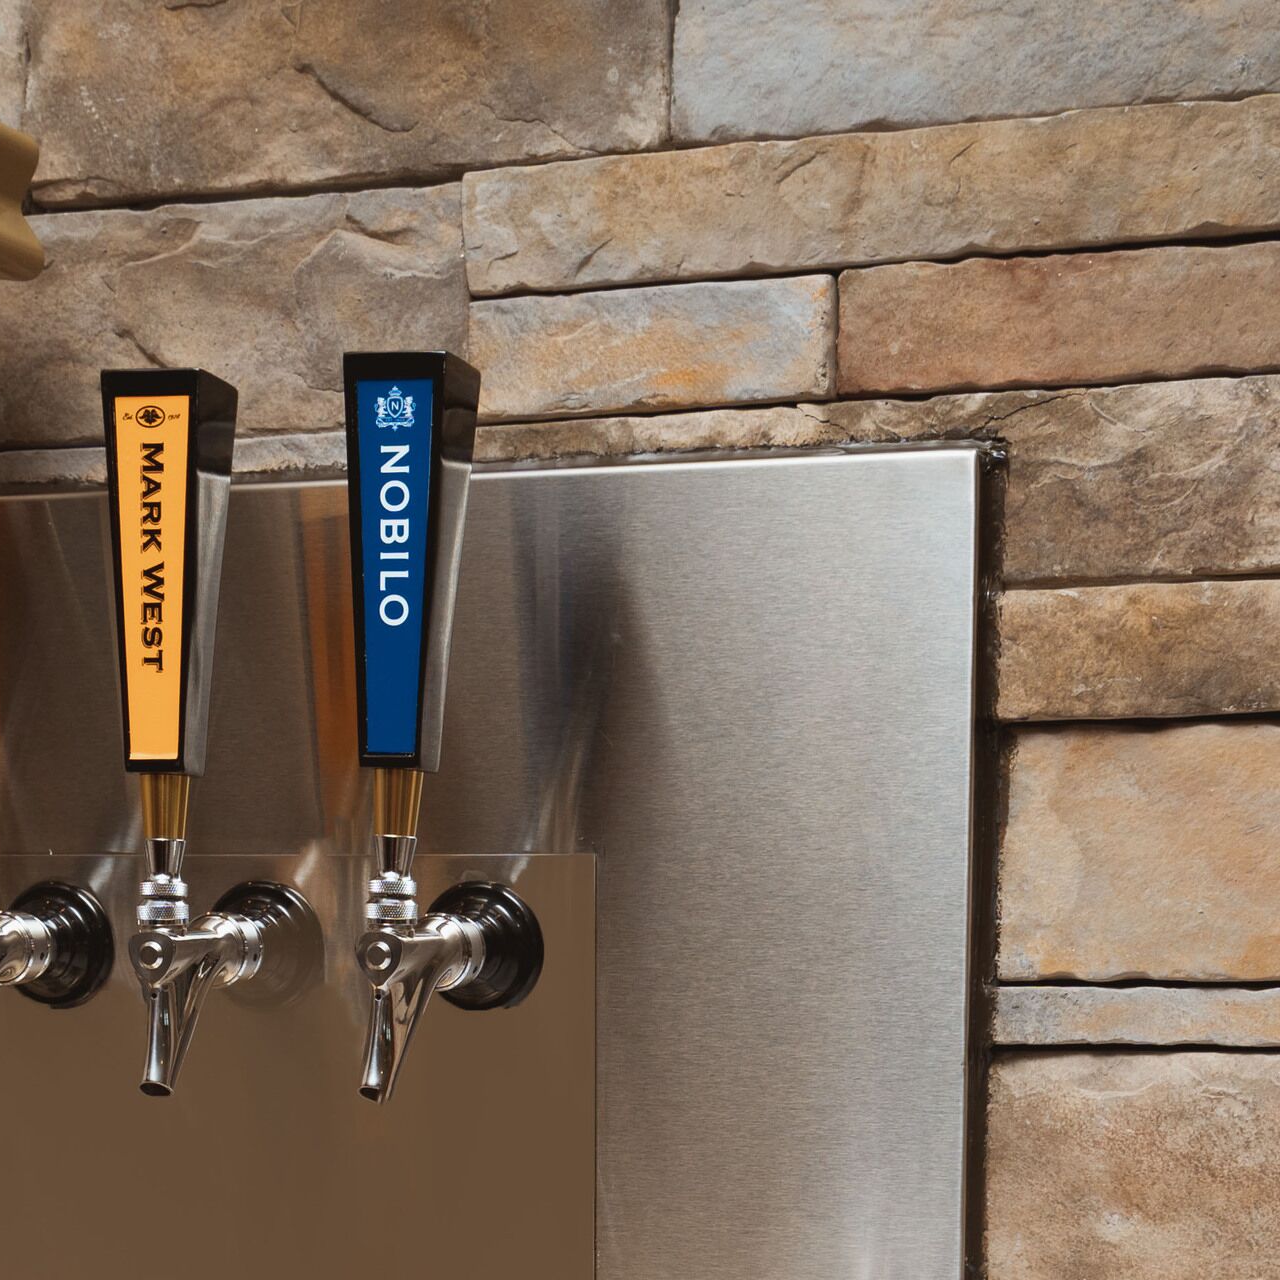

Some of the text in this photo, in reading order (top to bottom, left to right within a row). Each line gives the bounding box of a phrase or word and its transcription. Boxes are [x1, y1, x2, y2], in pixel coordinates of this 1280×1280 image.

[140, 441, 165, 674] MARK WEST
[379, 444, 411, 627] NOBILO
